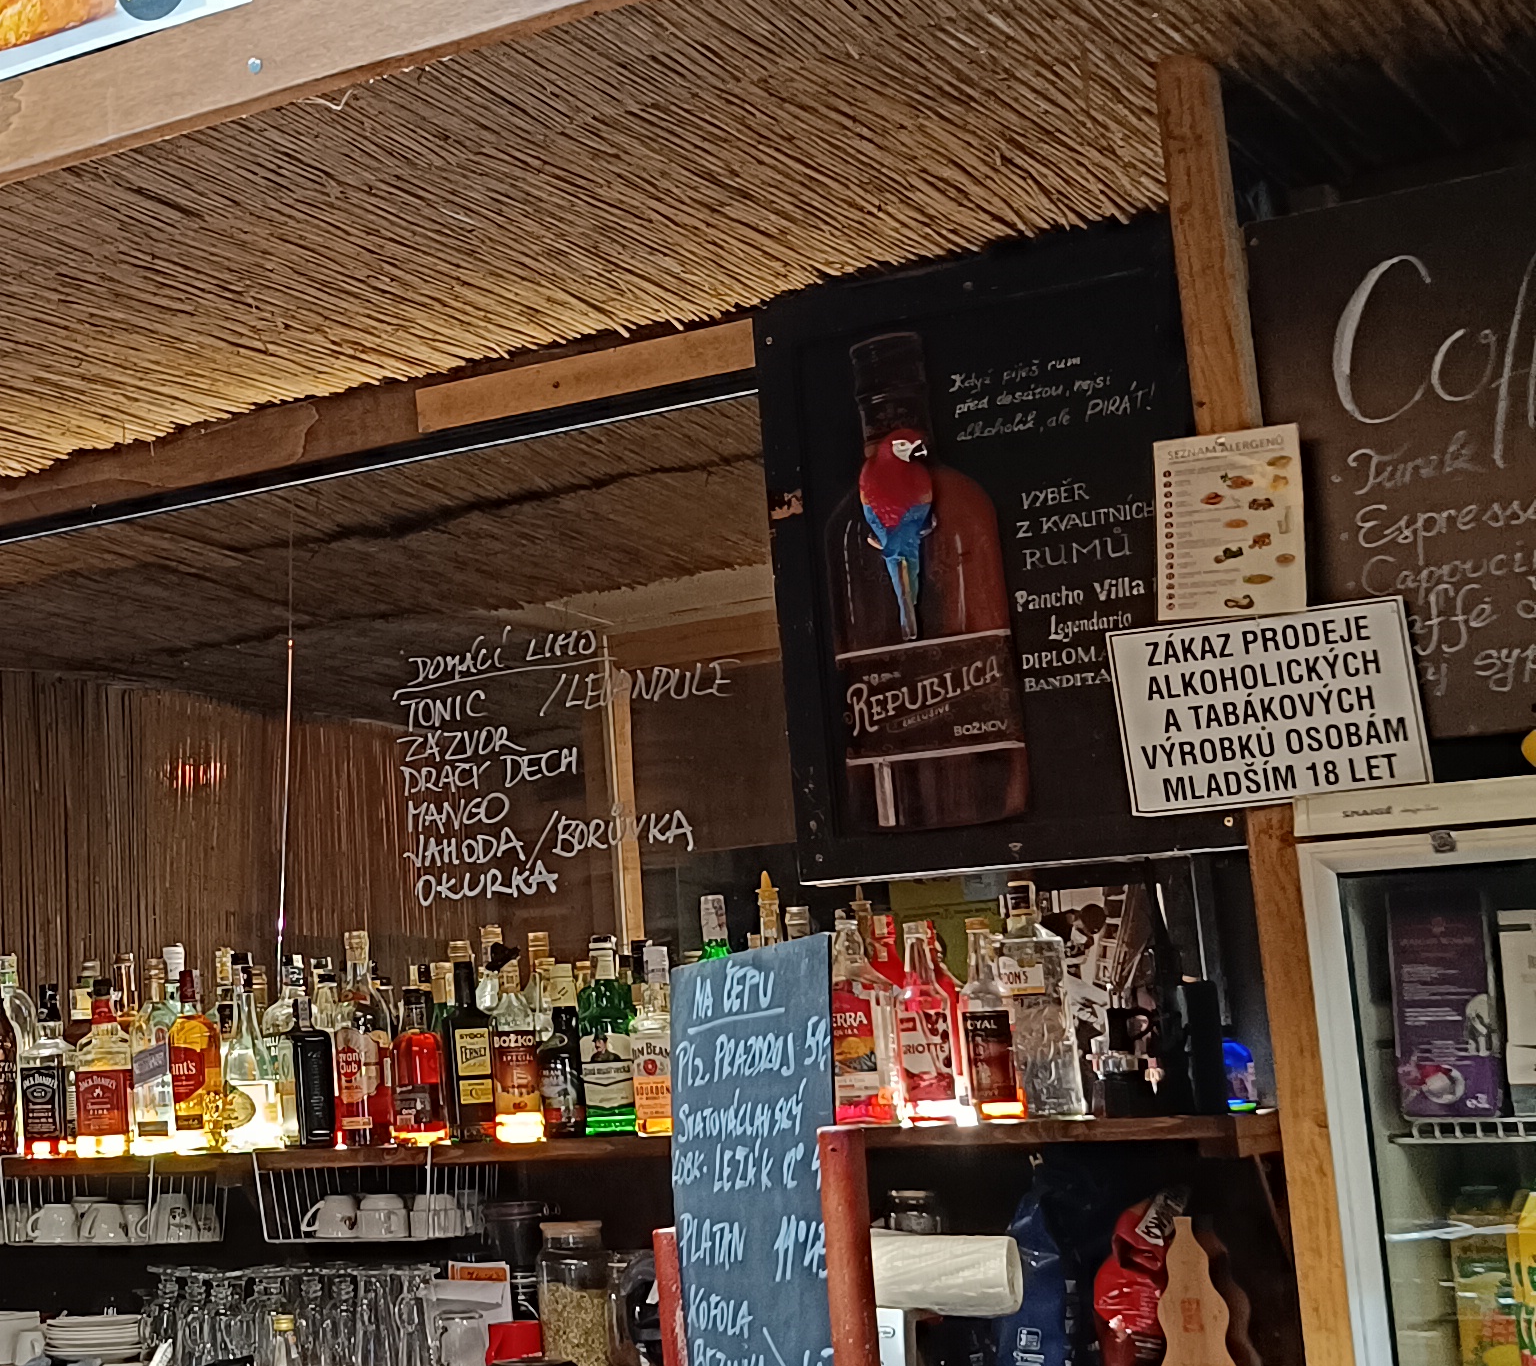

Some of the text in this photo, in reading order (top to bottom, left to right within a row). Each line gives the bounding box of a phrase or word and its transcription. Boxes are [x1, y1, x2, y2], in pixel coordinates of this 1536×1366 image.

[1047, 356, 1081, 371] rum
[1167, 446, 1216, 461] SEZNAM
[1016, 521, 1033, 538] Z
[1022, 526, 1133, 570] RUMŮ
[1015, 577, 1145, 612] Pancho Villa
[1049, 611, 1132, 643] Legendario
[1145, 615, 1371, 667] ZÁKAZ PRODEJE
[408, 626, 596, 685] DOMÁCÍ LIMO
[1148, 647, 1381, 702] ALKOHOLICKÝCH
[400, 690, 489, 732] TONIC
[846, 655, 1002, 736] REPUBLICA
[1164, 683, 1375, 734] A TABÁKOVÝCH
[397, 726, 527, 762] ZÁZVOR
[1140, 712, 1408, 770] VÝROBKŮ OSOBÁM
[500, 746, 579, 788] DECH
[1162, 752, 1397, 803] MLADŠÍM 18 LET
[407, 793, 510, 834] MANGO
[415, 860, 558, 908] OKURKA
[693, 959, 774, 1020] NA ČEPU
[687, 1283, 753, 1339] KOFOLA
